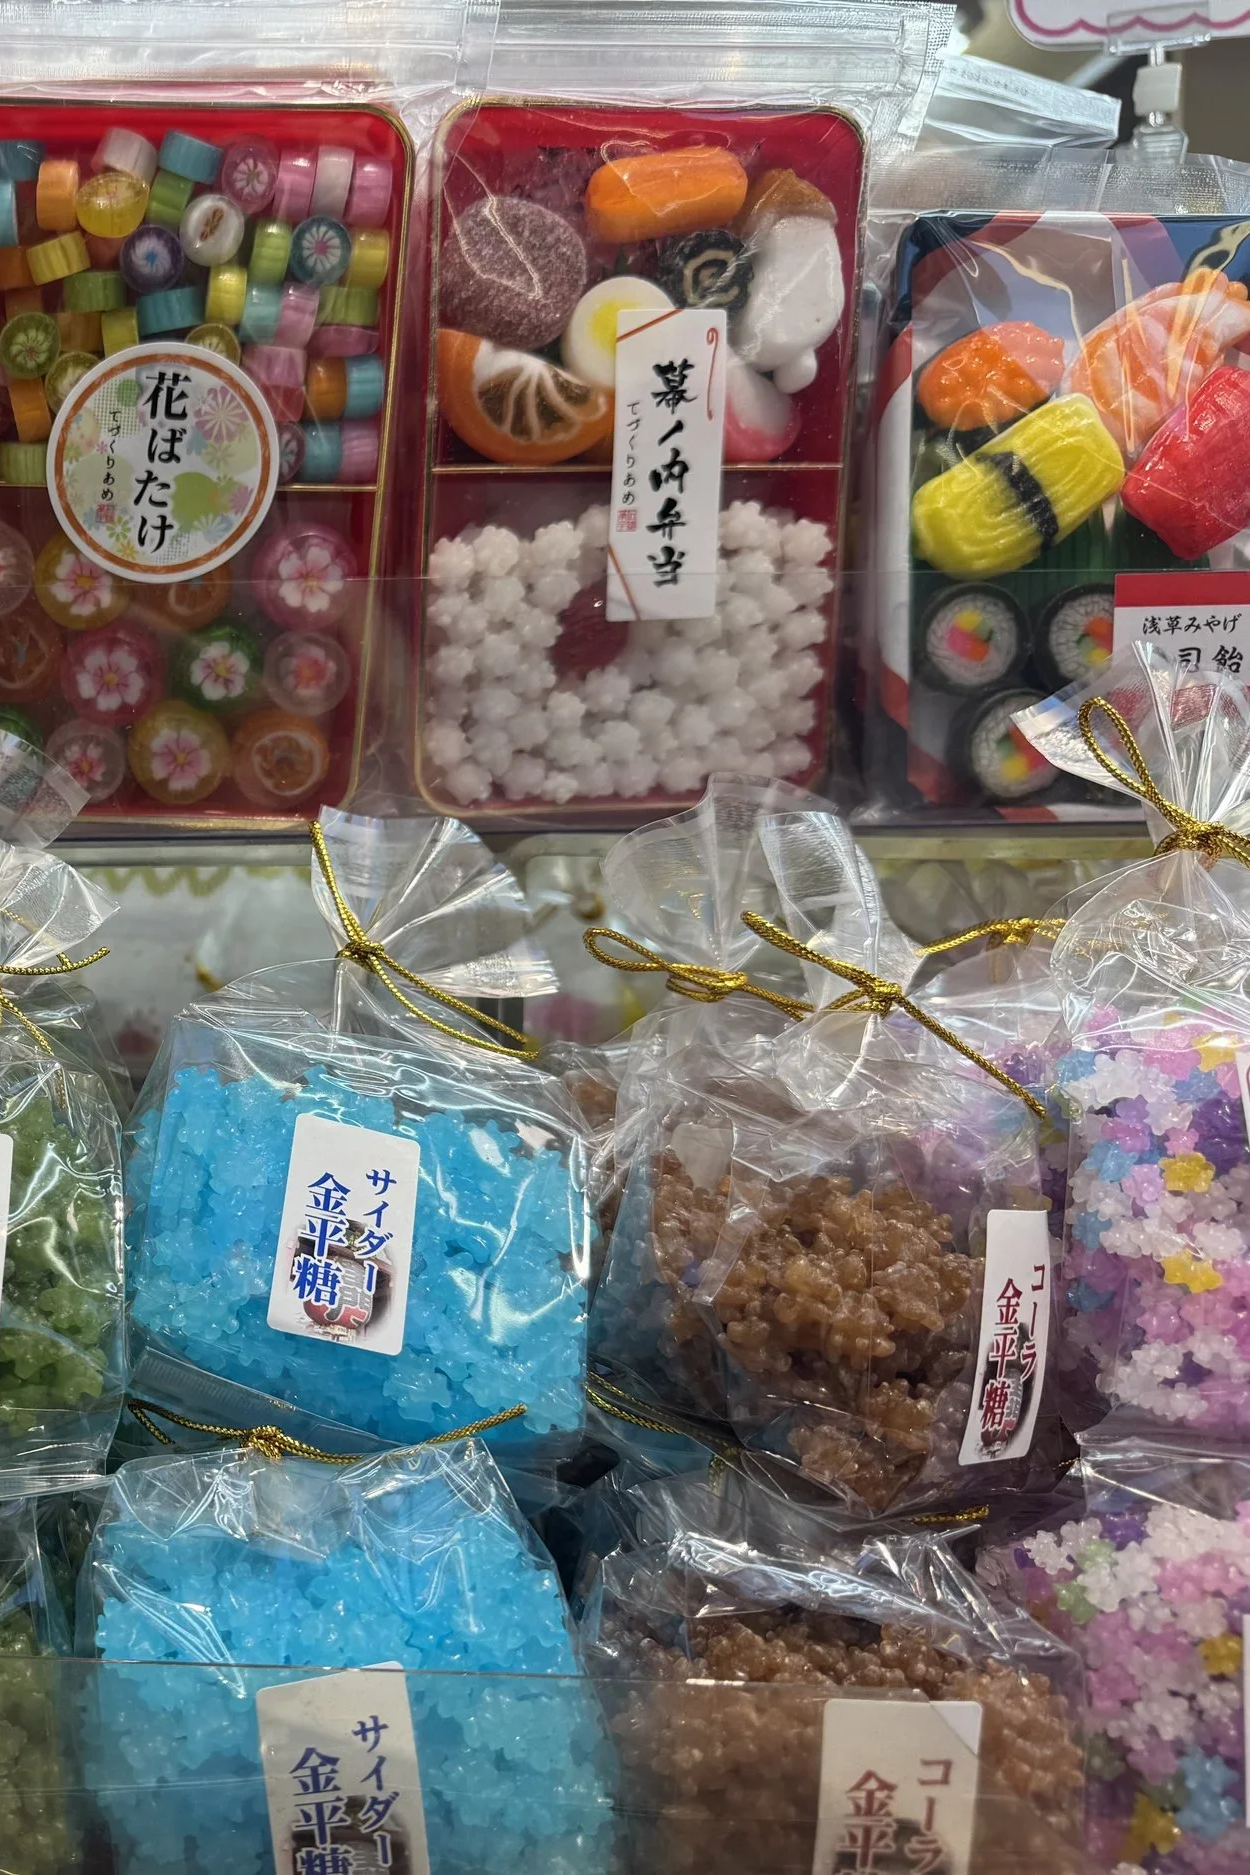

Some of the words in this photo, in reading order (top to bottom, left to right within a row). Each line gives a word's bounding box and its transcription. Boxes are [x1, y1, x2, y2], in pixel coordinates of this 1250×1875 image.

[100, 410, 122, 502] てづくりあめ
[132, 371, 193, 554] 花ばたけ
[622, 400, 642, 505] てづくりあめ
[646, 358, 698, 587] 幕ノ内弁当
[1141, 613, 1243, 636] 浅草みやげ
[1156, 644, 1244, 674] 司飴
[292, 1171, 352, 1306] 金平糖
[354, 1168, 398, 1293] サイダー
[981, 1277, 1024, 1431] 金平糖
[1020, 1263, 1047, 1382] コーラ
[351, 1714, 400, 1866] サイダー
[836, 1769, 899, 1875] 金平
[904, 1757, 954, 1875] コーラ
